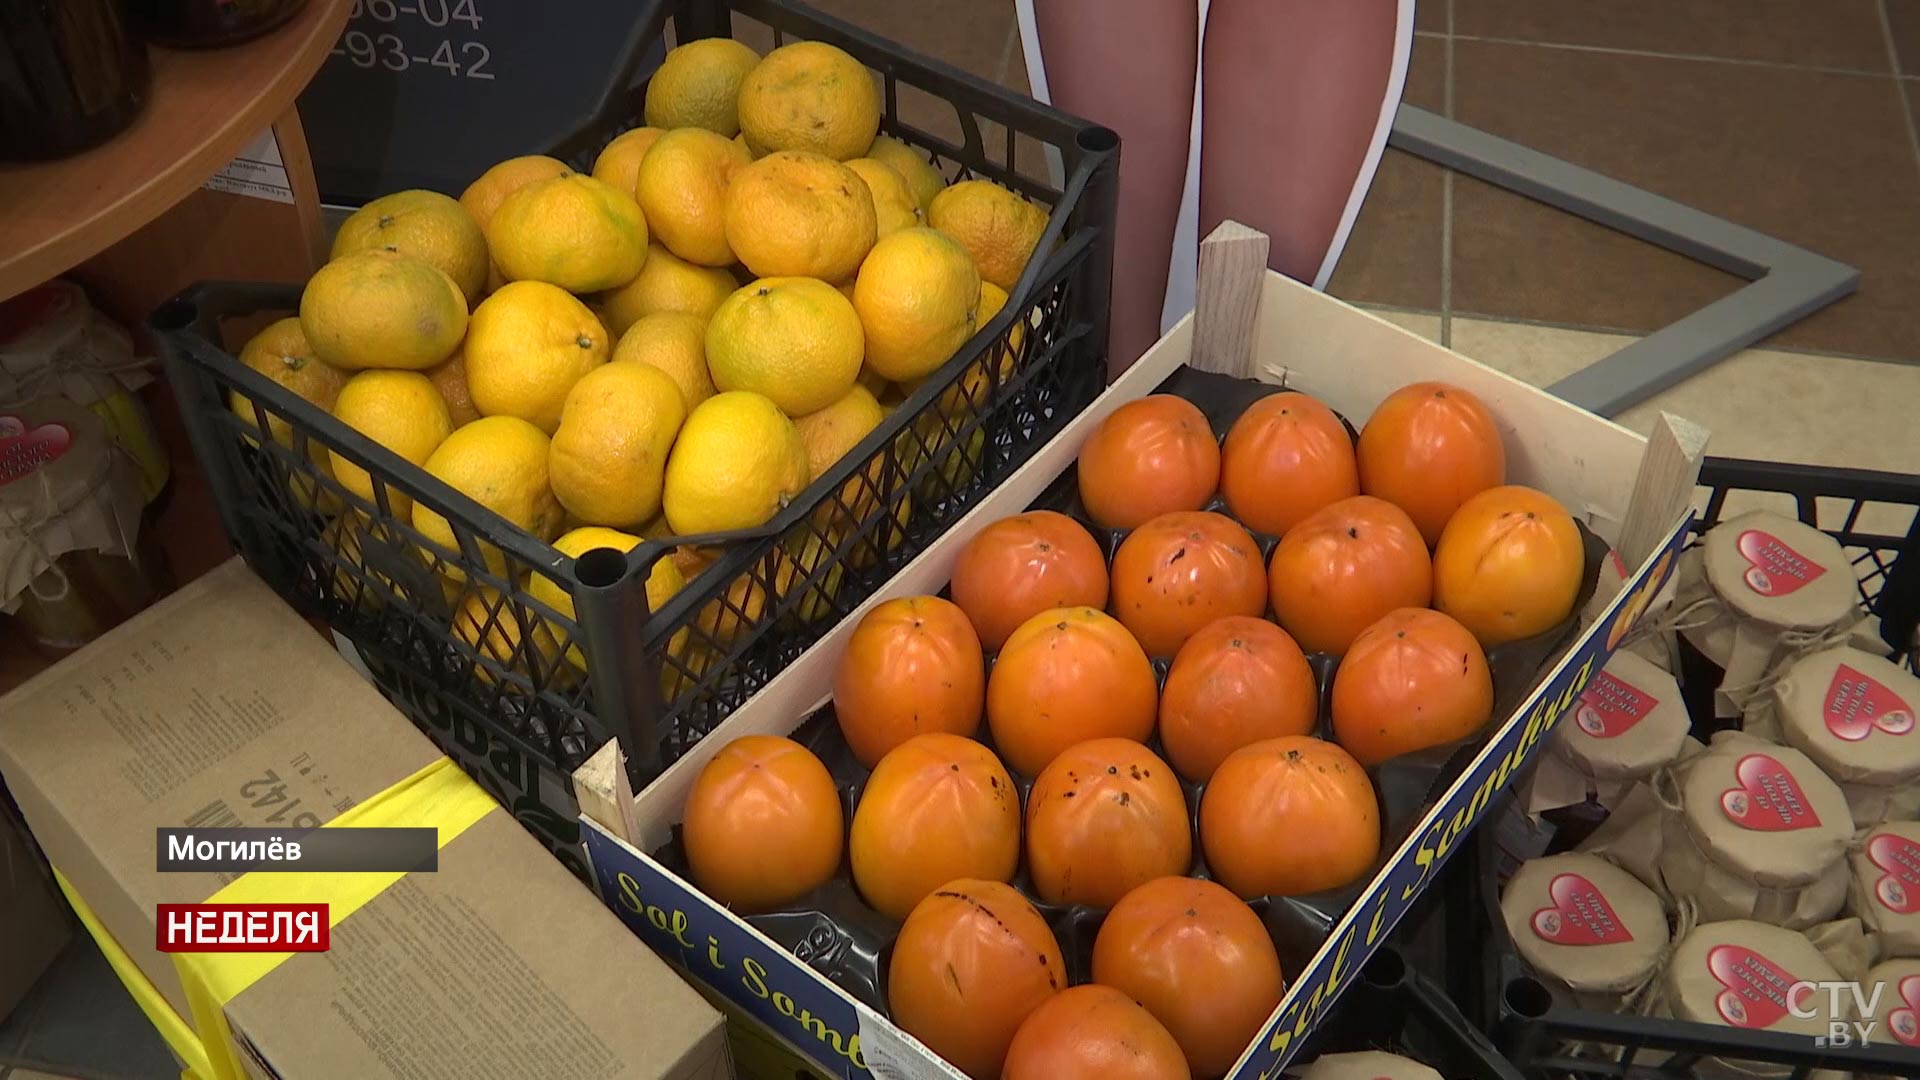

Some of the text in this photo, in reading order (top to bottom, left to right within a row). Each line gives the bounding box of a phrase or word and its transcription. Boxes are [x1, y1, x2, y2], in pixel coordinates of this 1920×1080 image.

[350, 0, 483, 30] 6-04
[1259, 654, 1595, 1080] Sol i Sombra
[616, 872, 695, 949] Sol
[706, 935, 726, 970] i
[741, 957, 870, 1070] Somb
